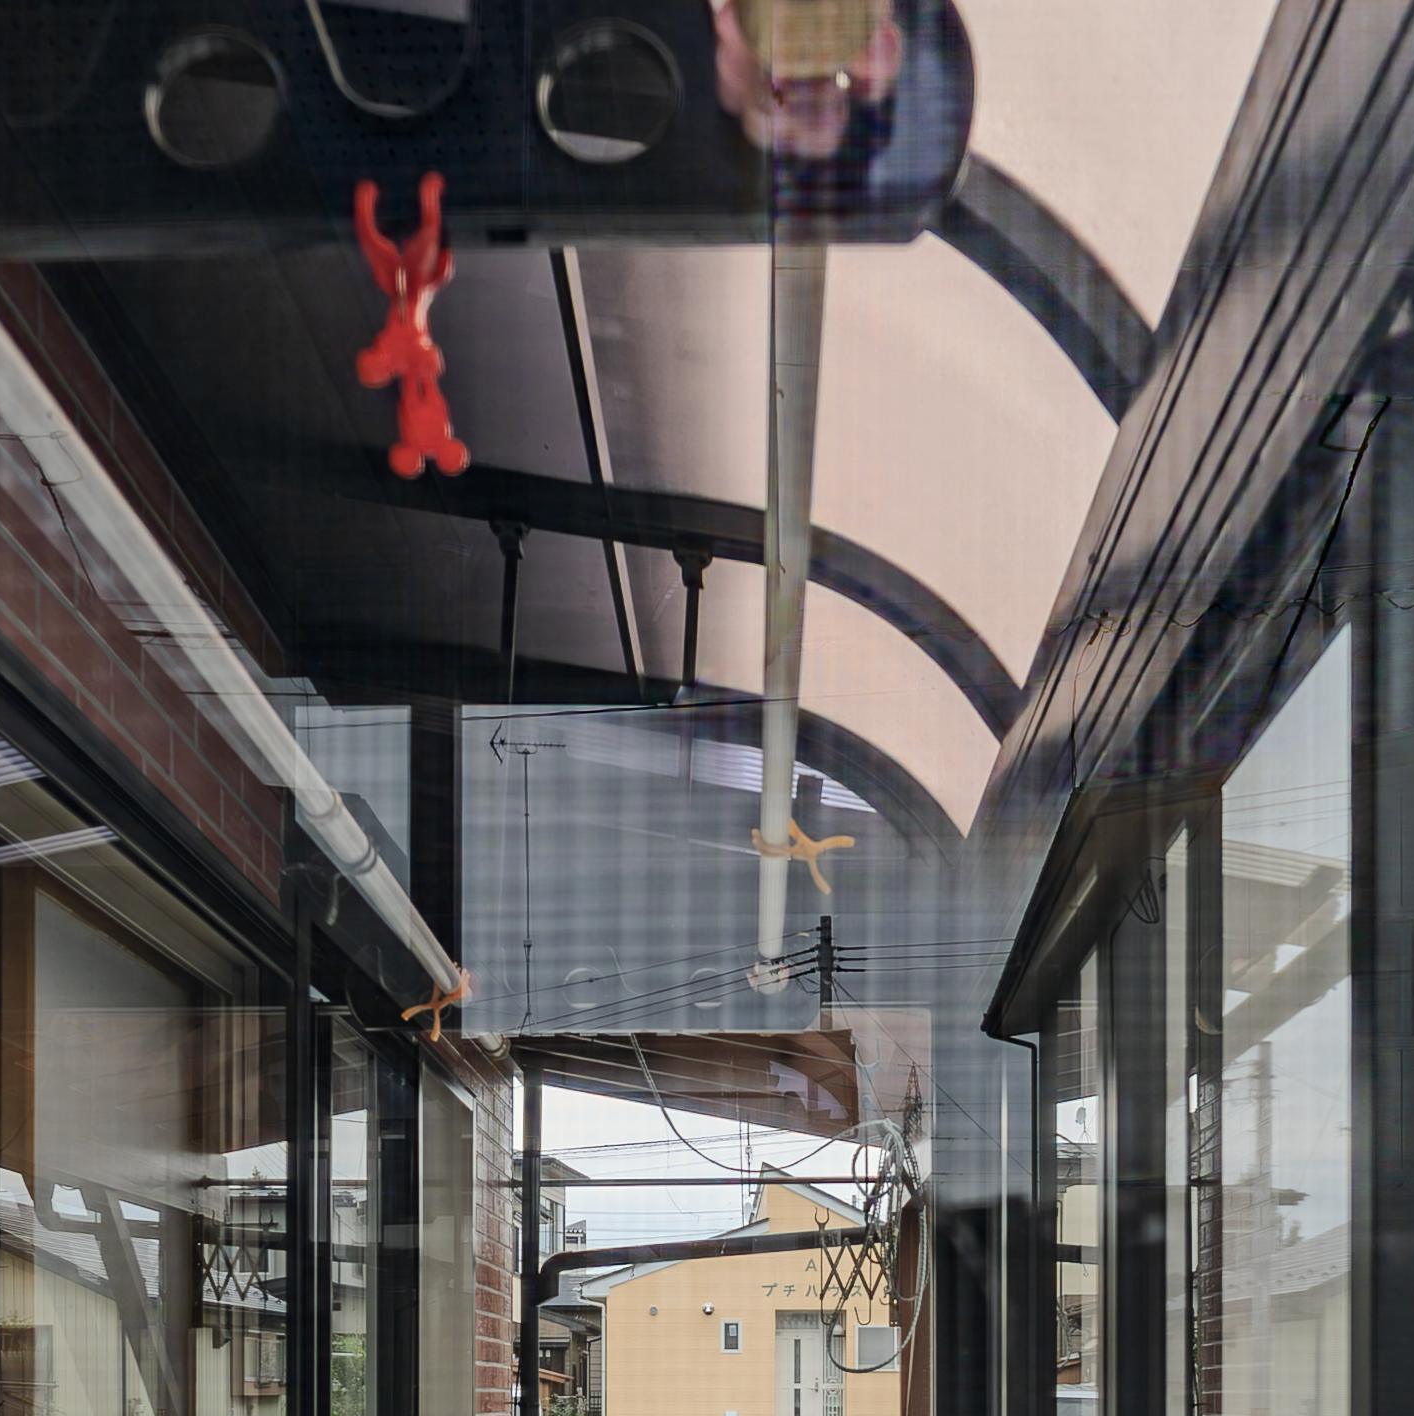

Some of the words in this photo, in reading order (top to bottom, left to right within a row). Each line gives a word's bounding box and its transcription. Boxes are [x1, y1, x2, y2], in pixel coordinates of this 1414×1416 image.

[804, 1258, 818, 1272] A
[761, 1282, 862, 1297] プチハウス
